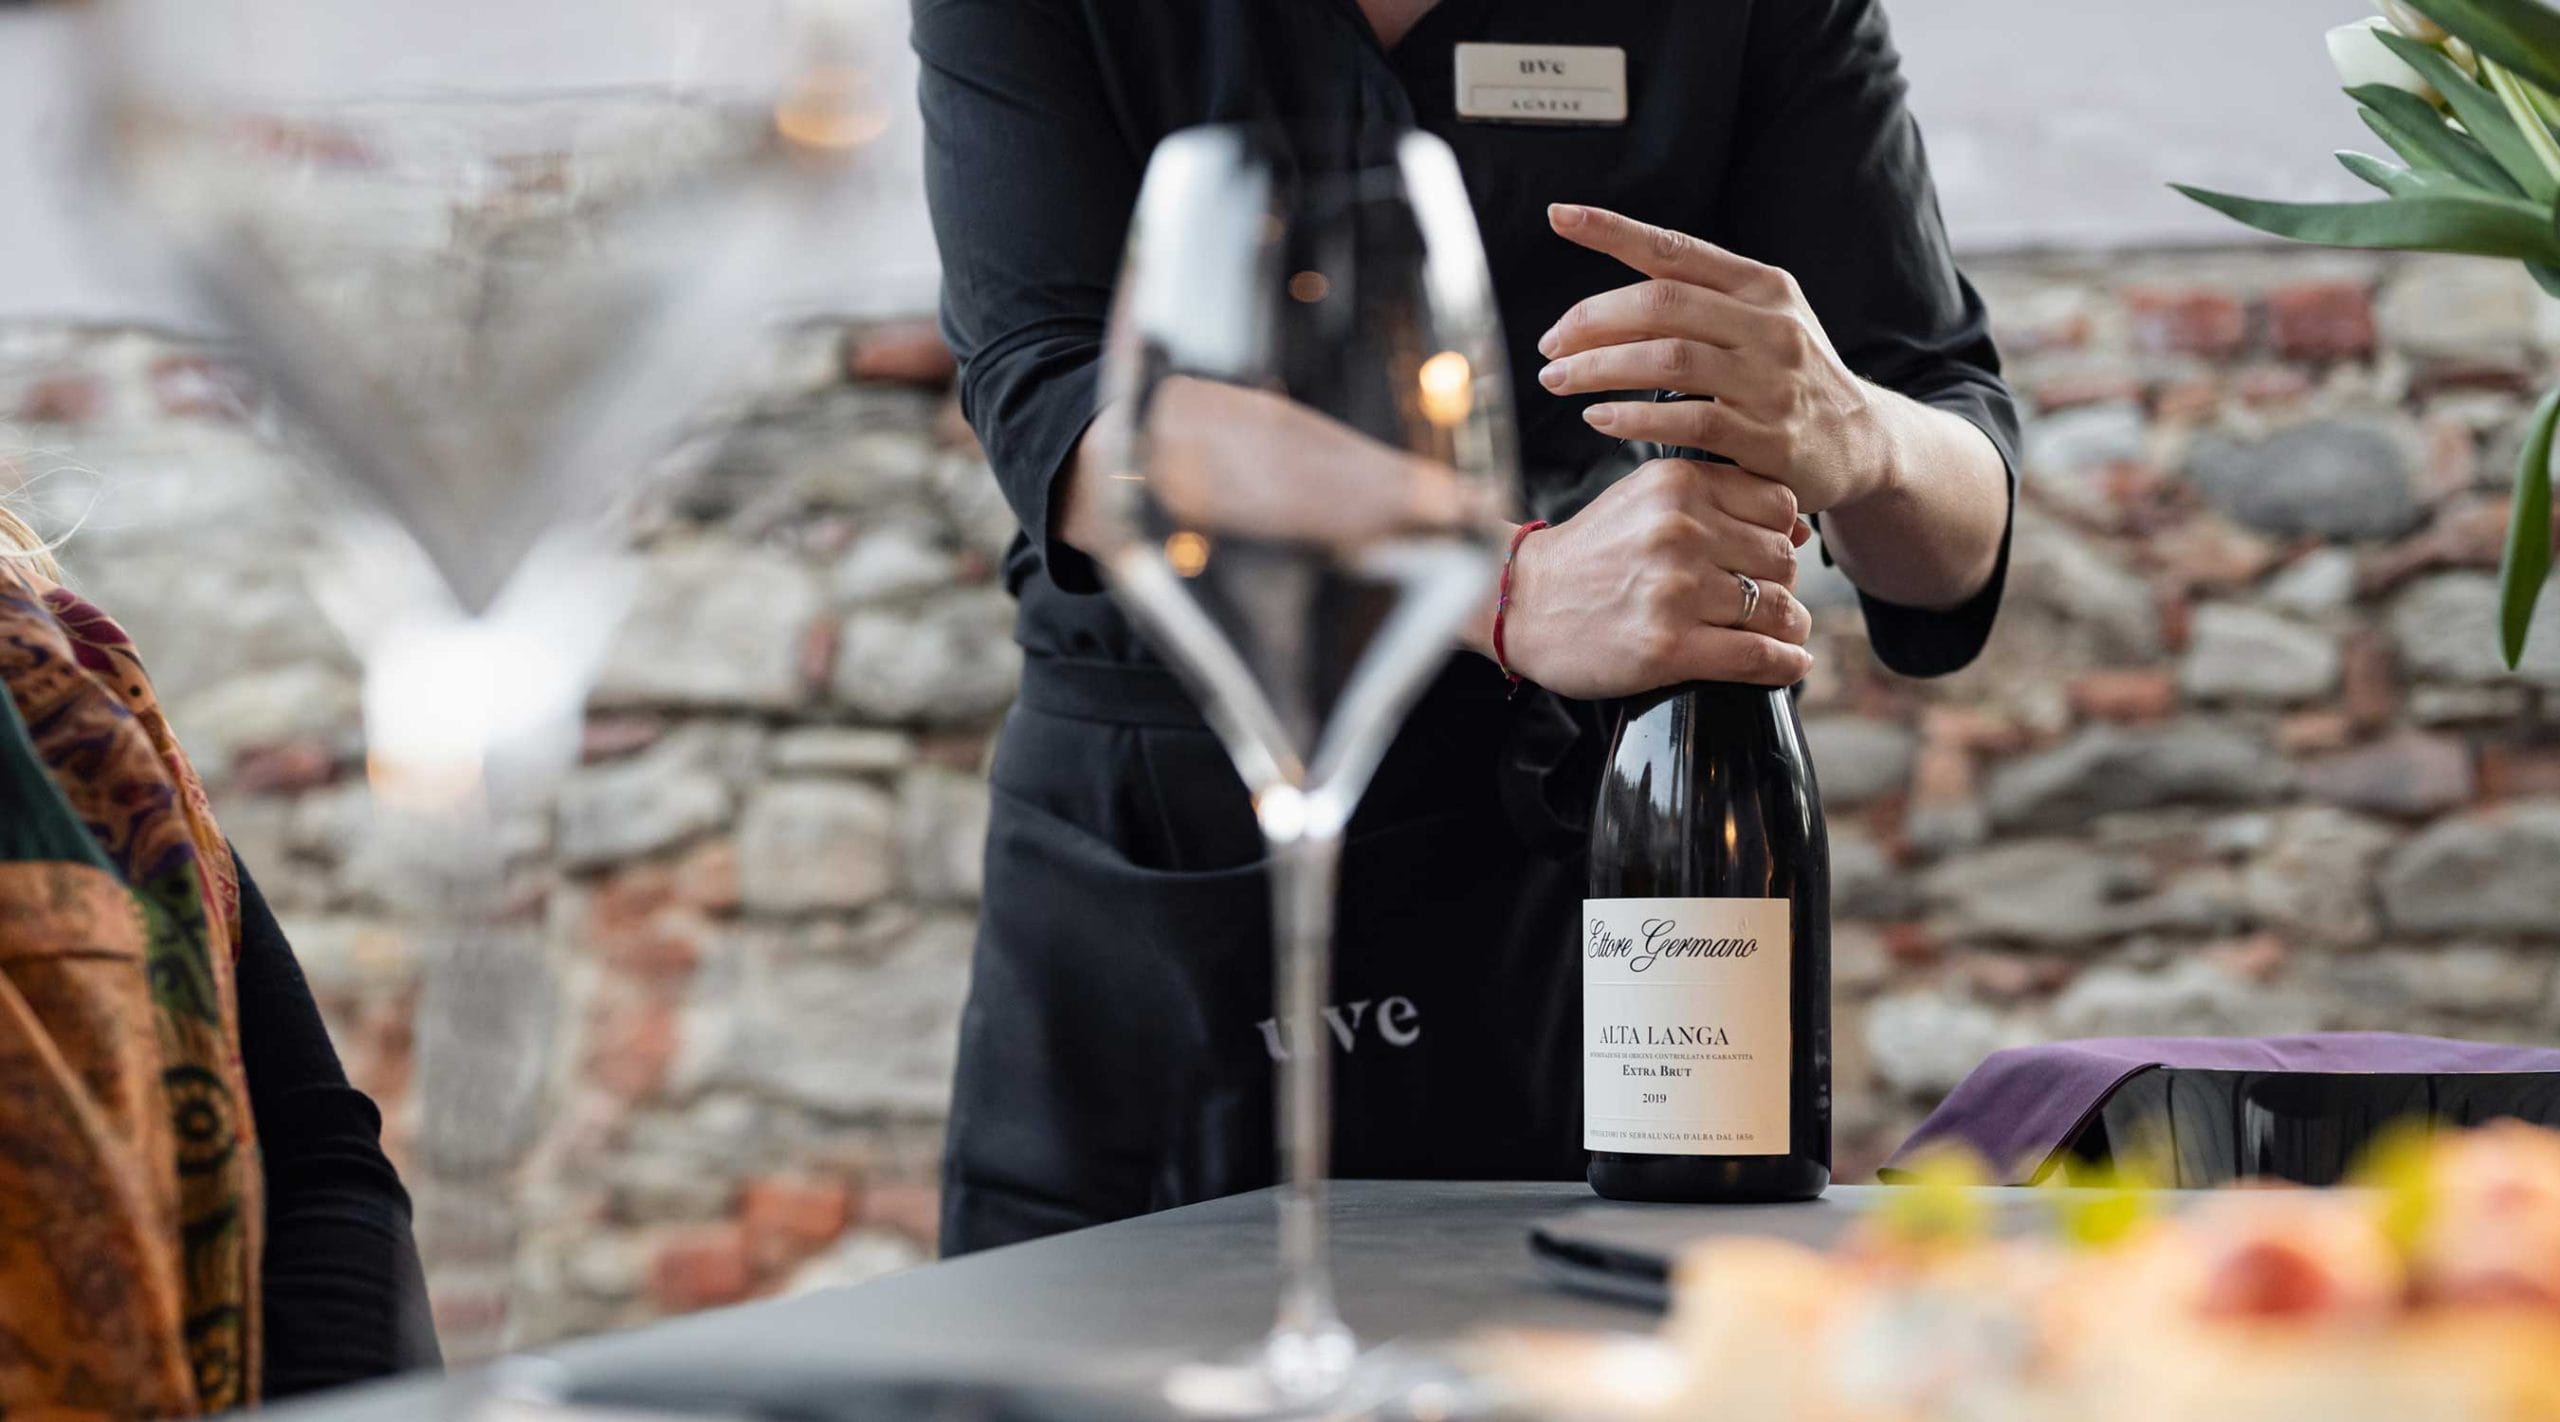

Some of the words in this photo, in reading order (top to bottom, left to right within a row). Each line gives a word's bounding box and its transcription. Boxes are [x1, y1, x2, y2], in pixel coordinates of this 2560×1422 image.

[1588, 918, 1633, 959] Ettore
[1630, 918, 1758, 973] Germano
[1600, 1025, 1640, 1045] ALTA
[1648, 1026, 1729, 1046] LANGA
[1642, 1093, 1667, 1104] 2019
